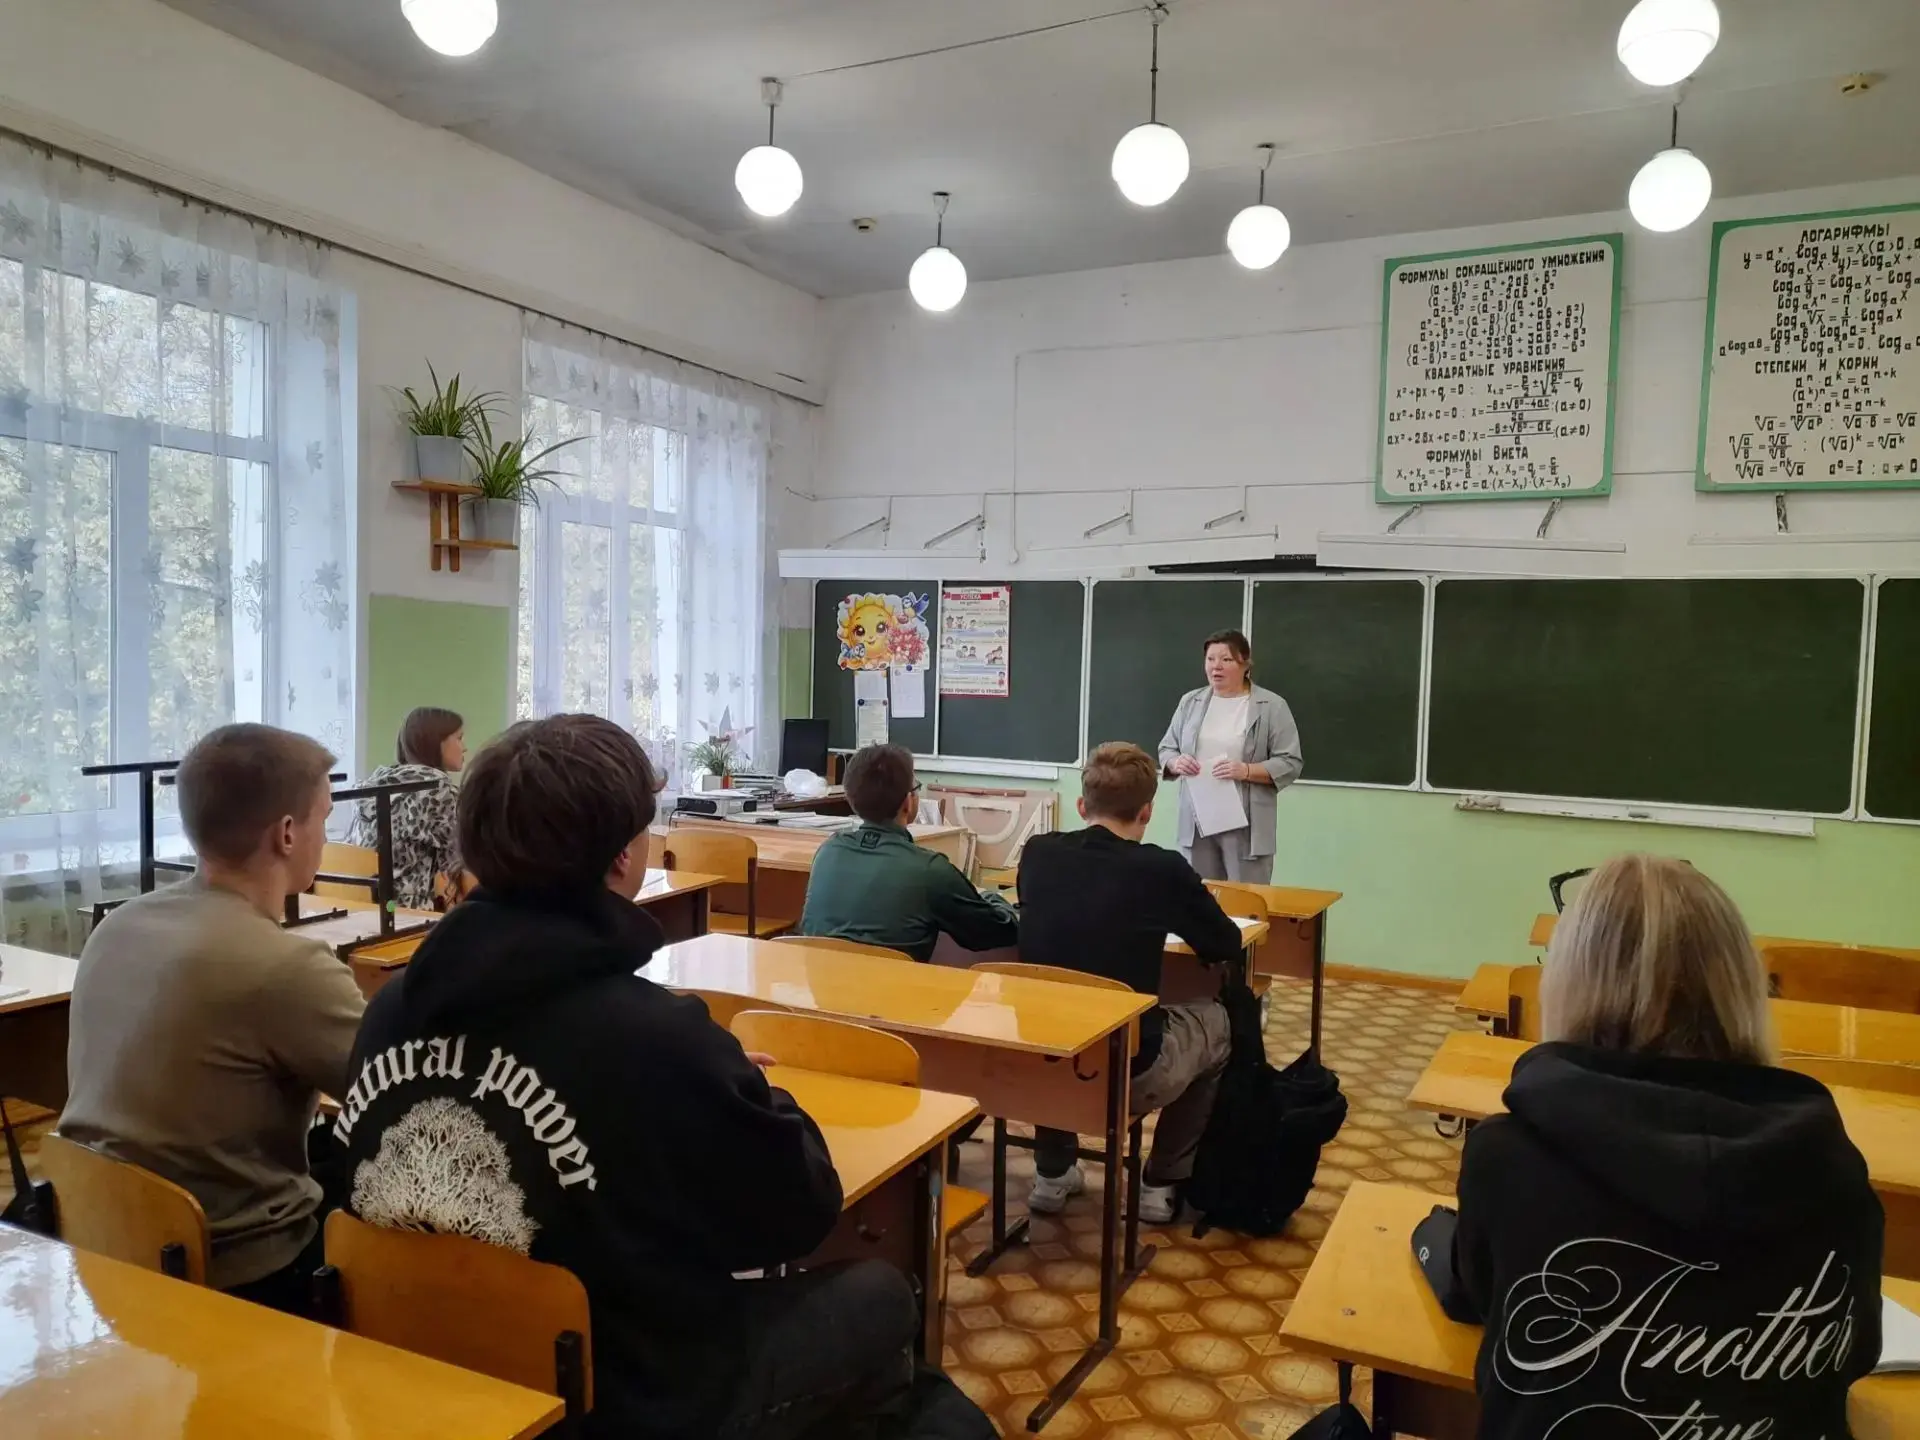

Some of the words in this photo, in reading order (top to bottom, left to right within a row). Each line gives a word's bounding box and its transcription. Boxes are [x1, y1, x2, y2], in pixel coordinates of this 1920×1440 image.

[1801, 224, 1890, 243] ЛОГАРИФМЫ
[1399, 268, 1448, 284] ФОРМУЛЫ
[1456, 258, 1534, 278] СОКРАЩЁННОГО
[1542, 249, 1604, 268] УМНОЖЕНИЯ
[1425, 364, 1494, 380] КВАДРАТНЫЕ
[1503, 358, 1565, 375] УРАВНЕНИЯ
[1755, 360, 1806, 374] СТЕПЕНИ
[1819, 359, 1826, 371] И
[1839, 356, 1878, 371] КОРНИ
[1426, 448, 1482, 463] ФОРМУЛЫ
[1494, 446, 1528, 460] ВИЕТА
[332, 1034, 468, 1147] natural
[470, 1046, 599, 1192] power
